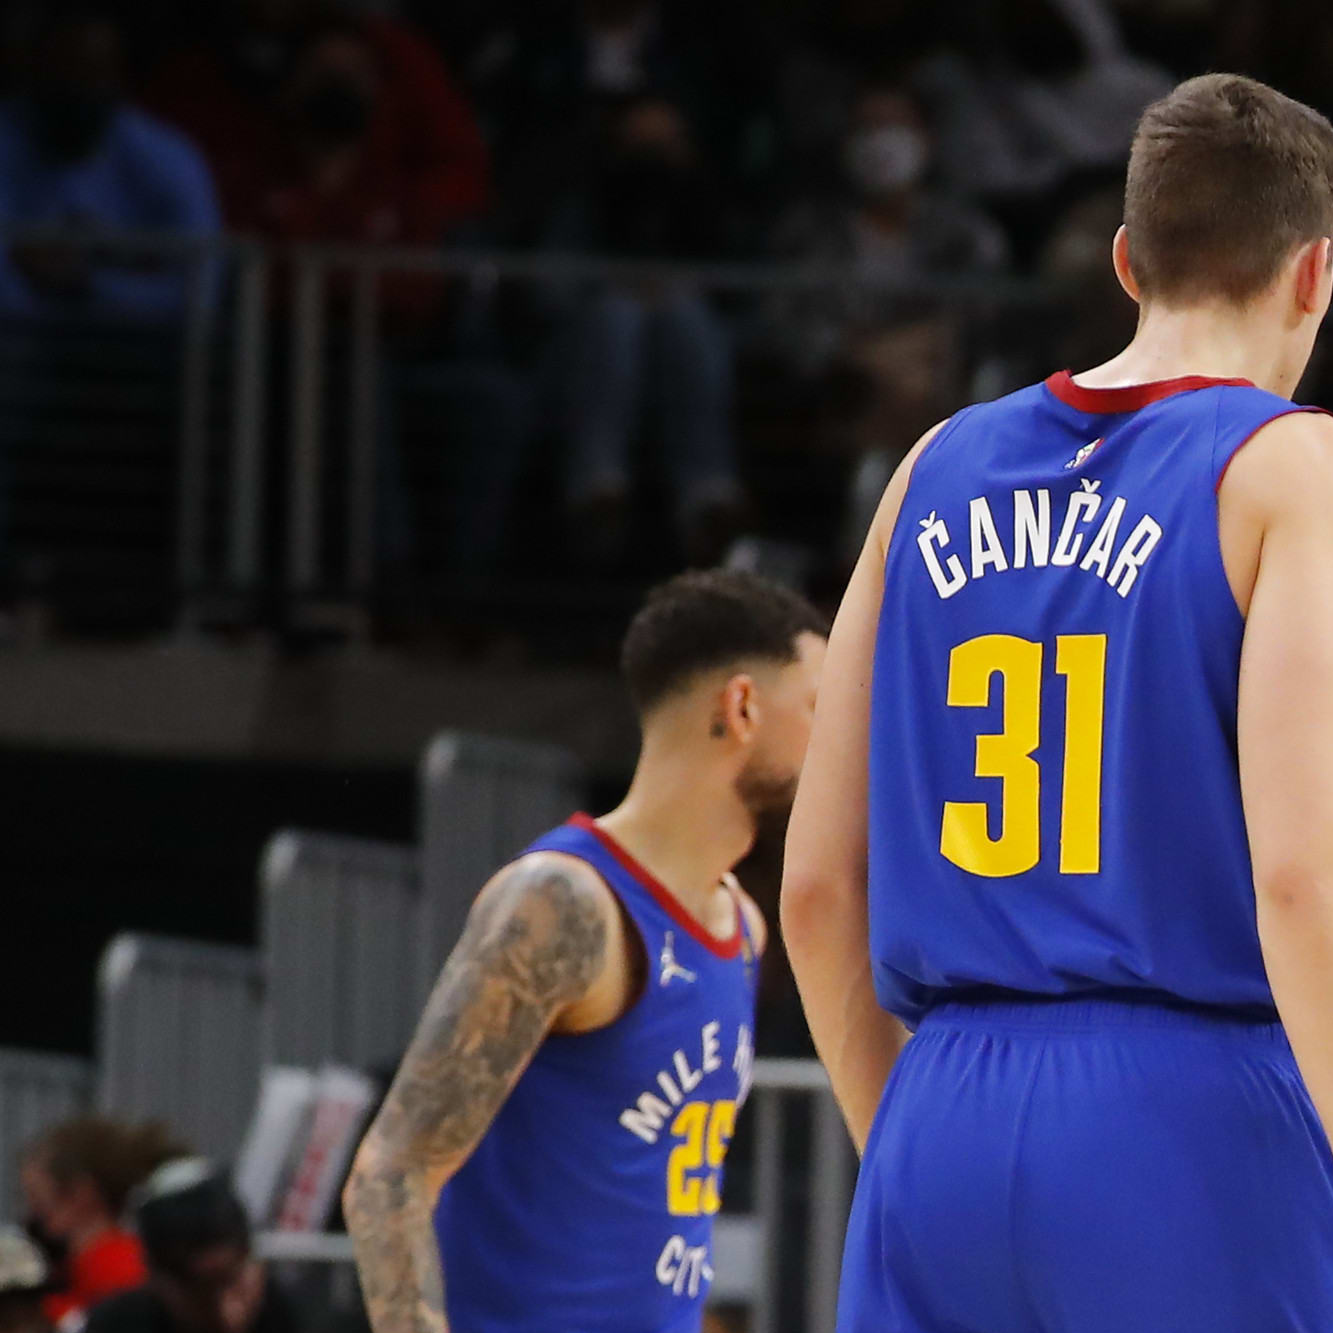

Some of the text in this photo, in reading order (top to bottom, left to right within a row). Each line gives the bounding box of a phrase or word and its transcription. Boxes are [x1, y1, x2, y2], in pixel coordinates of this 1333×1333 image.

[916, 478, 1163, 599] ČANČAR
[940, 634, 1107, 878] 31
[619, 1020, 722, 1145] MILE
[655, 1234, 714, 1299] CIT
